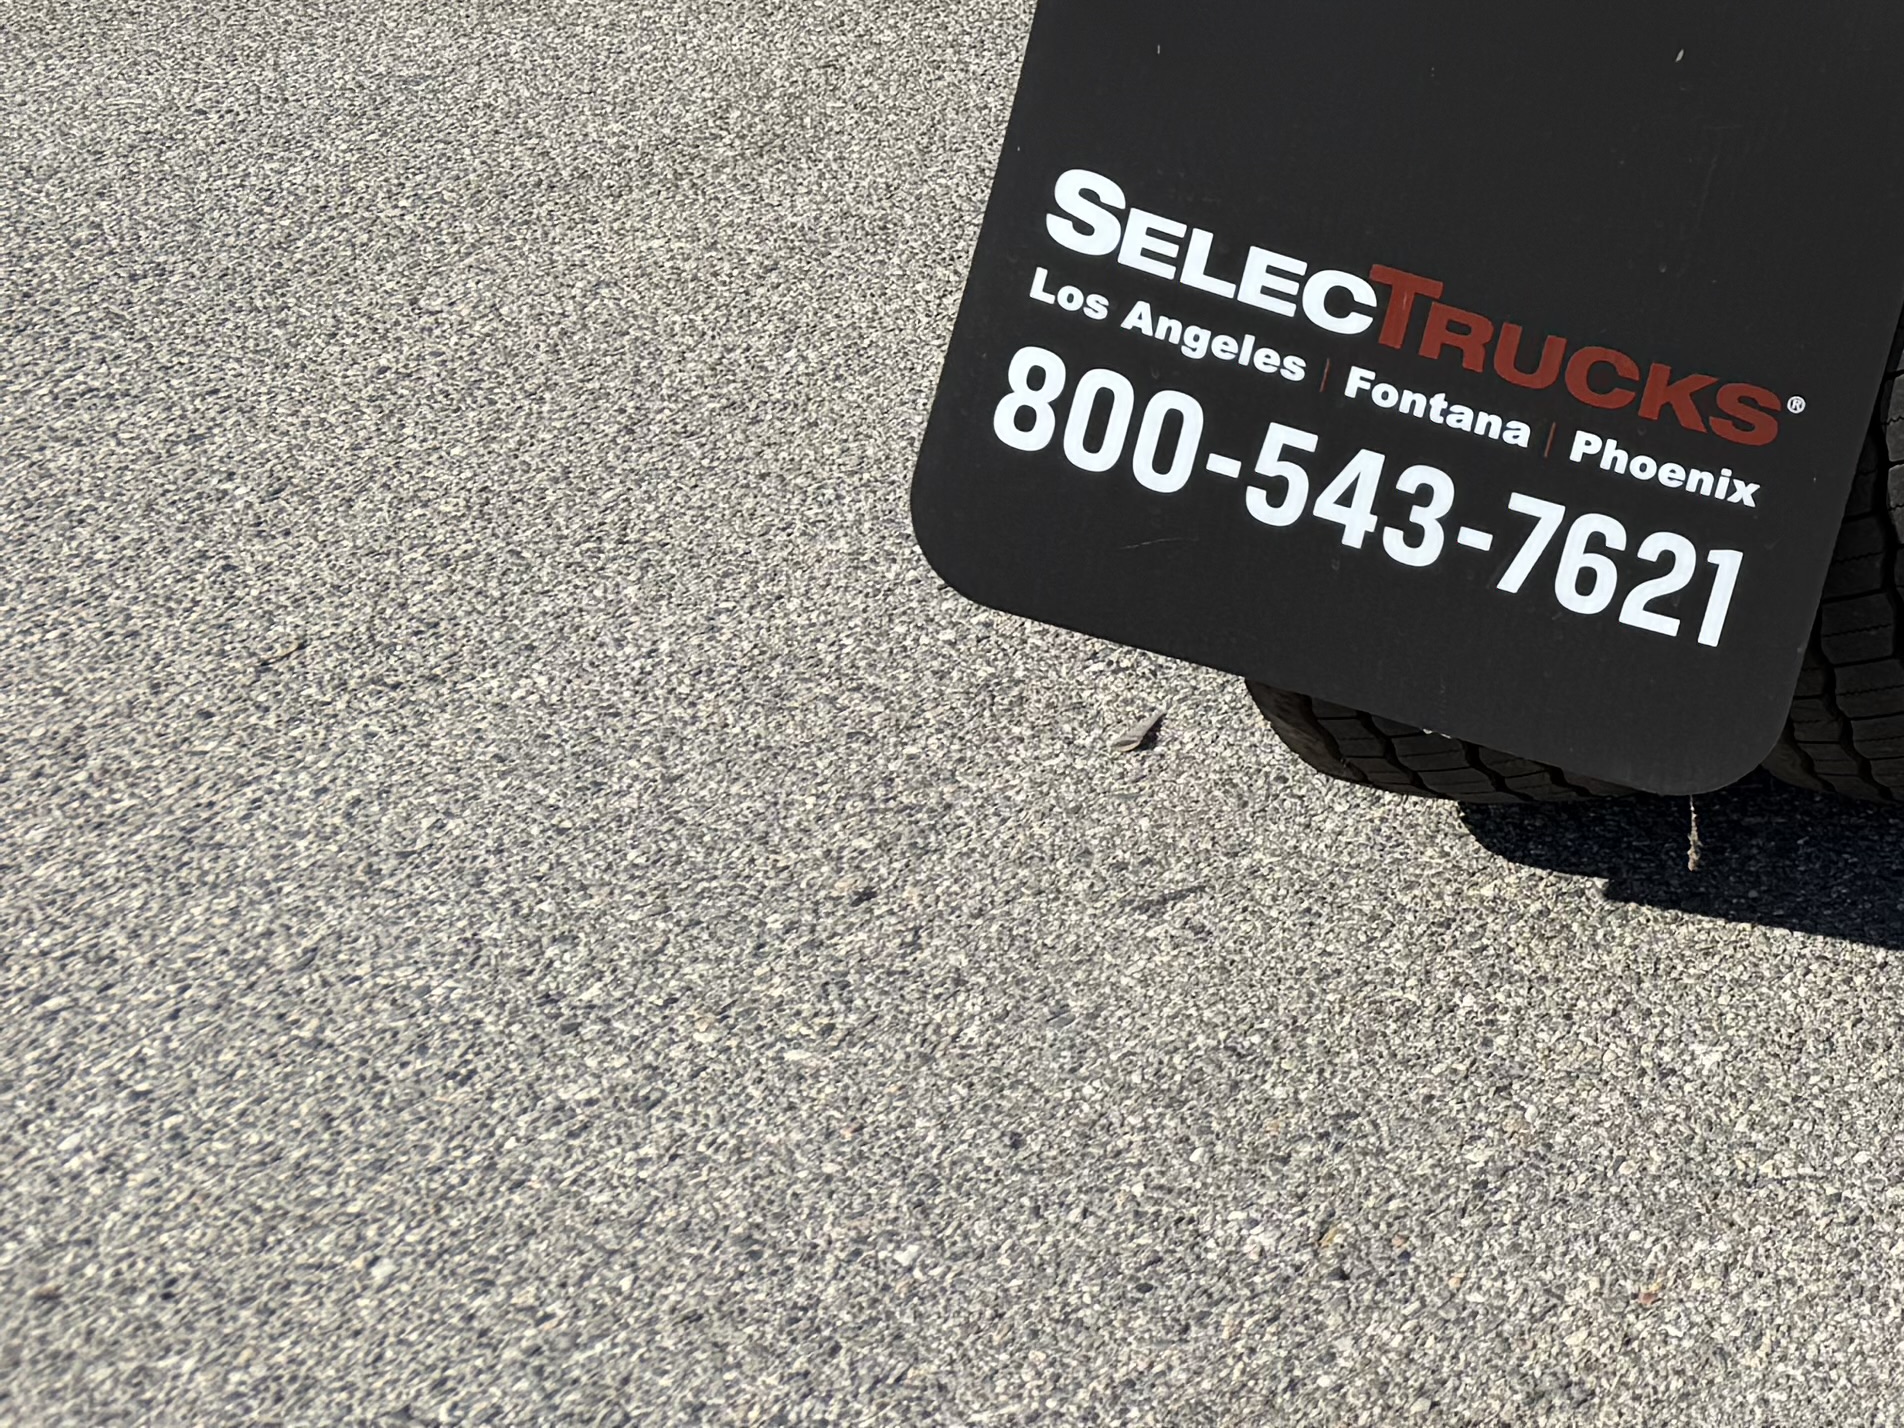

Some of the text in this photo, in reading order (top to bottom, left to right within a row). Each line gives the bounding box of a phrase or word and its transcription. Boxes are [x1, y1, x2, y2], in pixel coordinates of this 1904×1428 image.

[992, 345, 1745, 648] 800-543-7621
[1029, 267, 1762, 508] Los Angeles Fontana Phoenix
